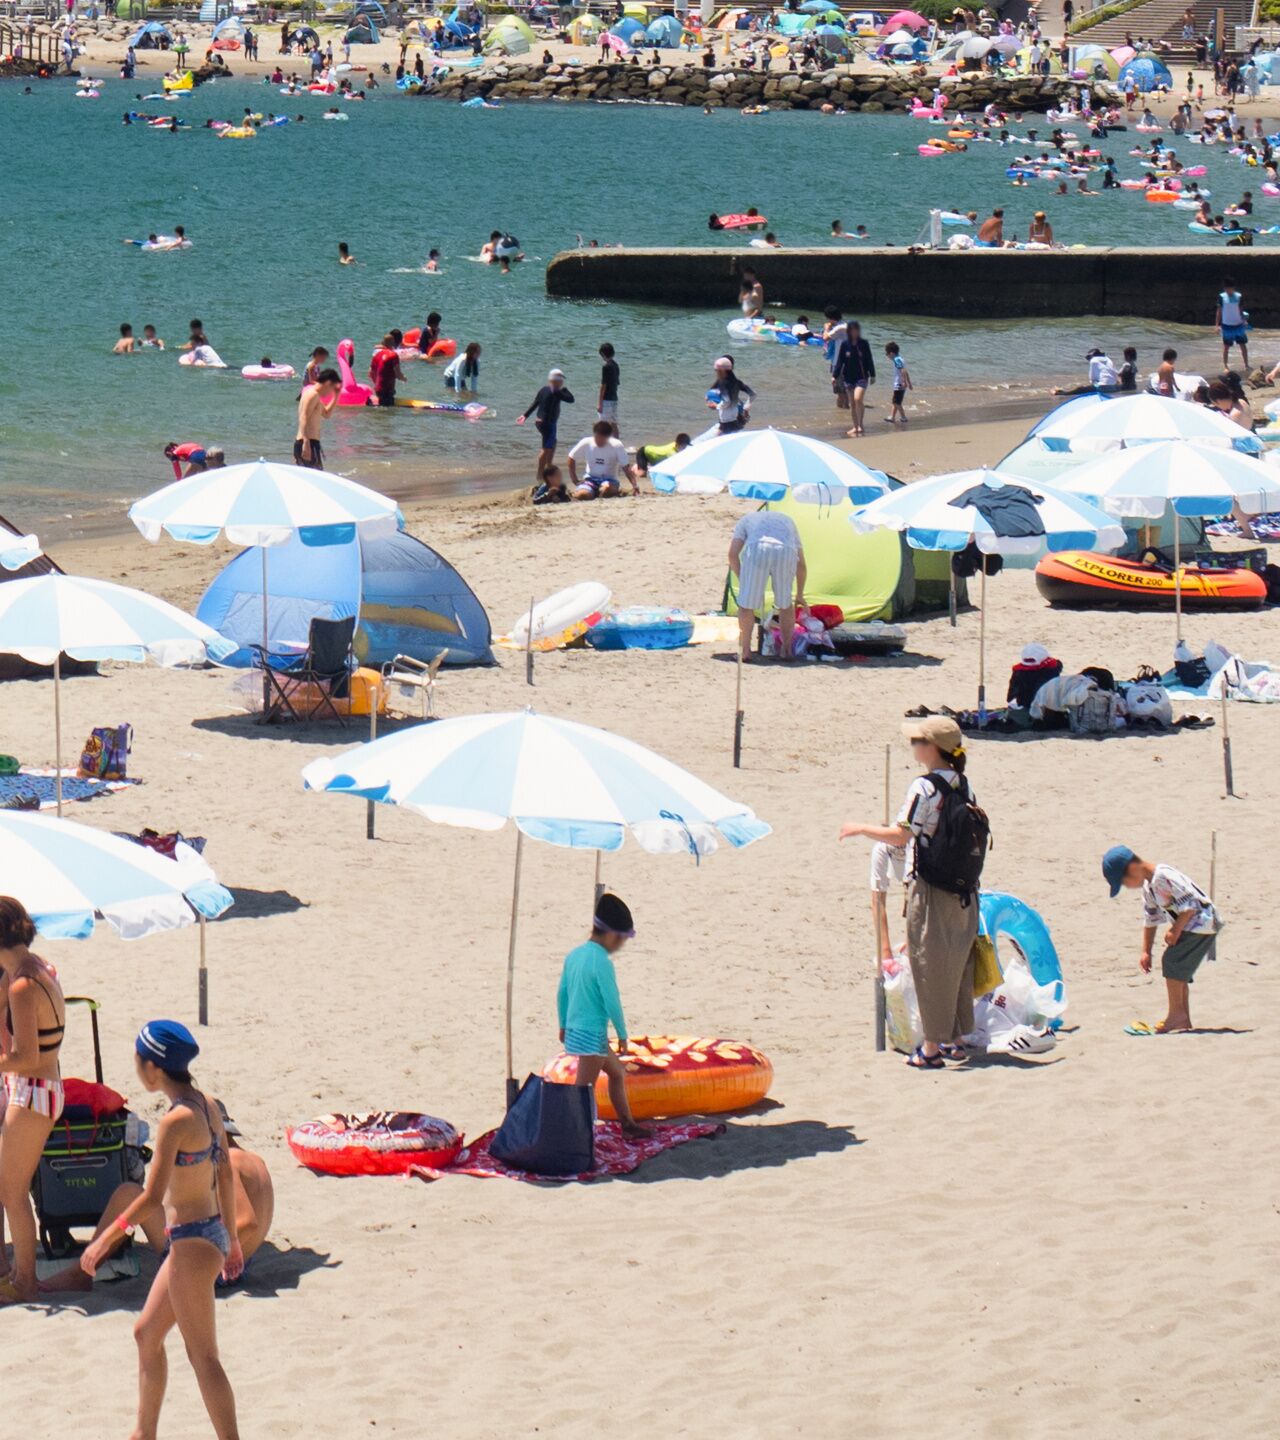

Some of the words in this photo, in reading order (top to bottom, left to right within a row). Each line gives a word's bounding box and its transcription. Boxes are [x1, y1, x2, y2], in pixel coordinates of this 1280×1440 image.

[1074, 557, 1144, 585] EXPLORER
[1145, 577, 1163, 587] 200
[64, 1176, 96, 1187] TITAN
